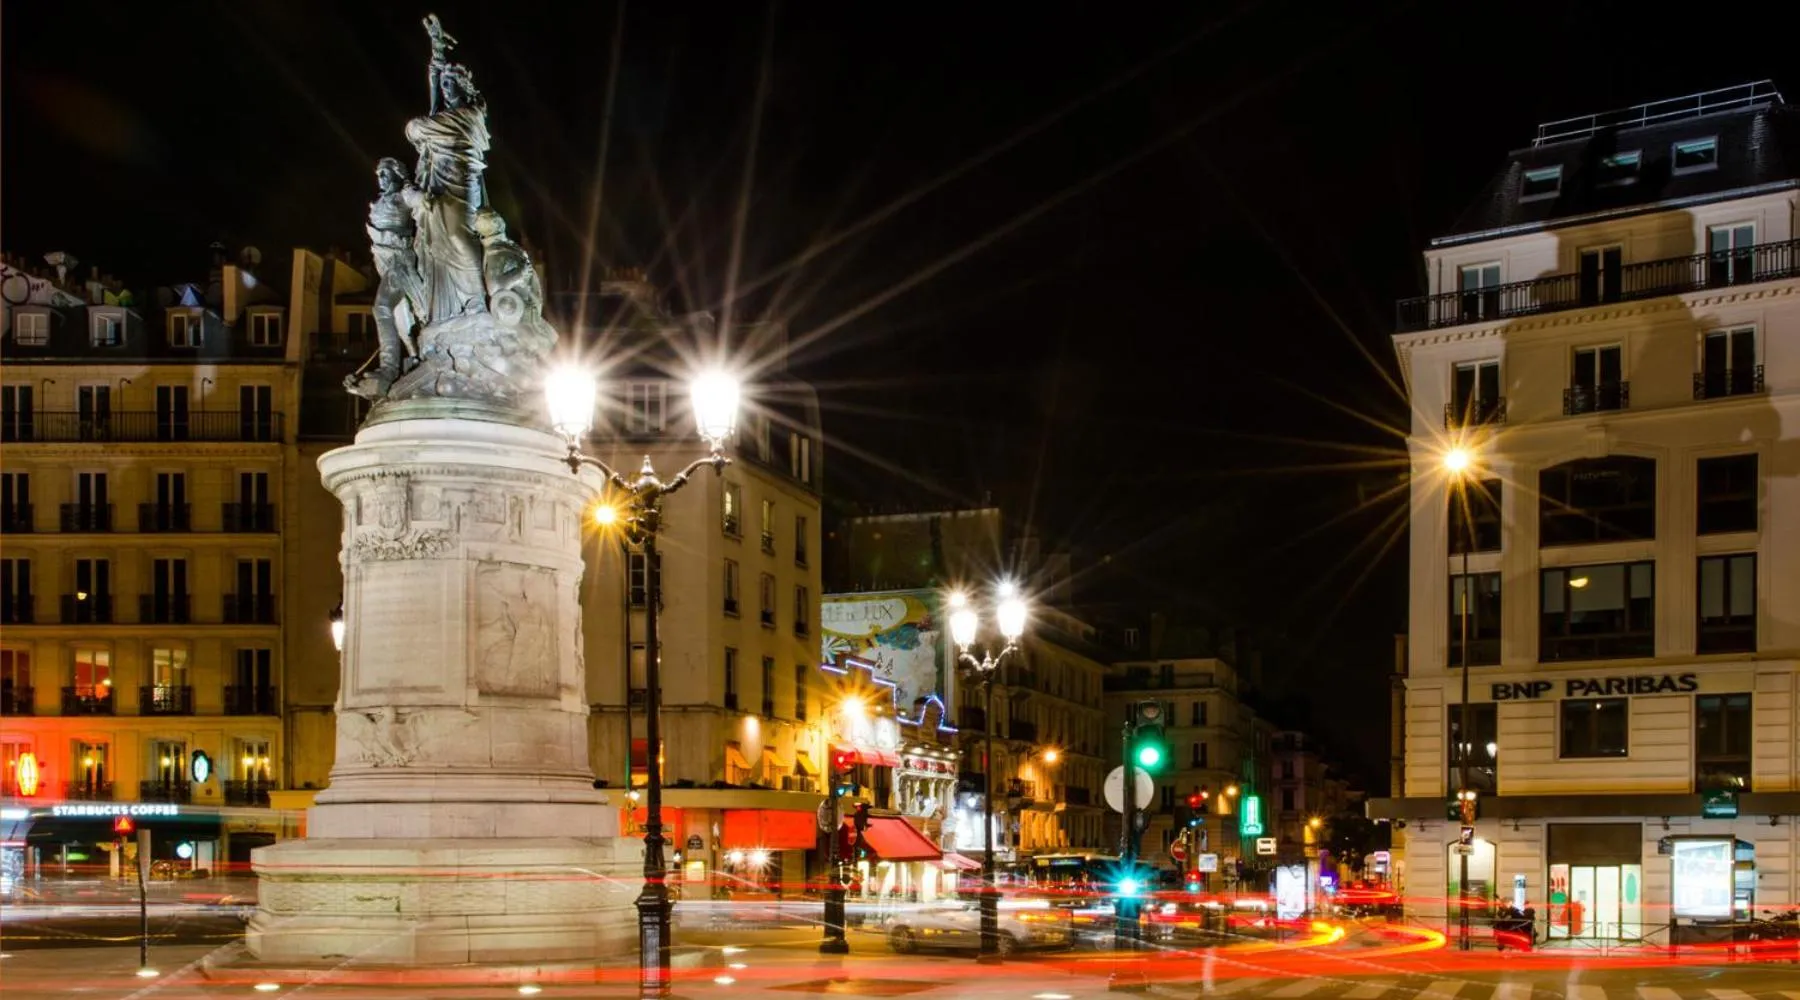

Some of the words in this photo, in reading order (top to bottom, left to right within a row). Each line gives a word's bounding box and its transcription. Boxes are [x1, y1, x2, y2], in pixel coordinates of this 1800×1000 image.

[1491, 679, 1553, 700] BNP
[1566, 673, 1699, 697] PARIBAS
[52, 804, 128, 816] STARBUCKS
[130, 804, 178, 815] COFFEE
